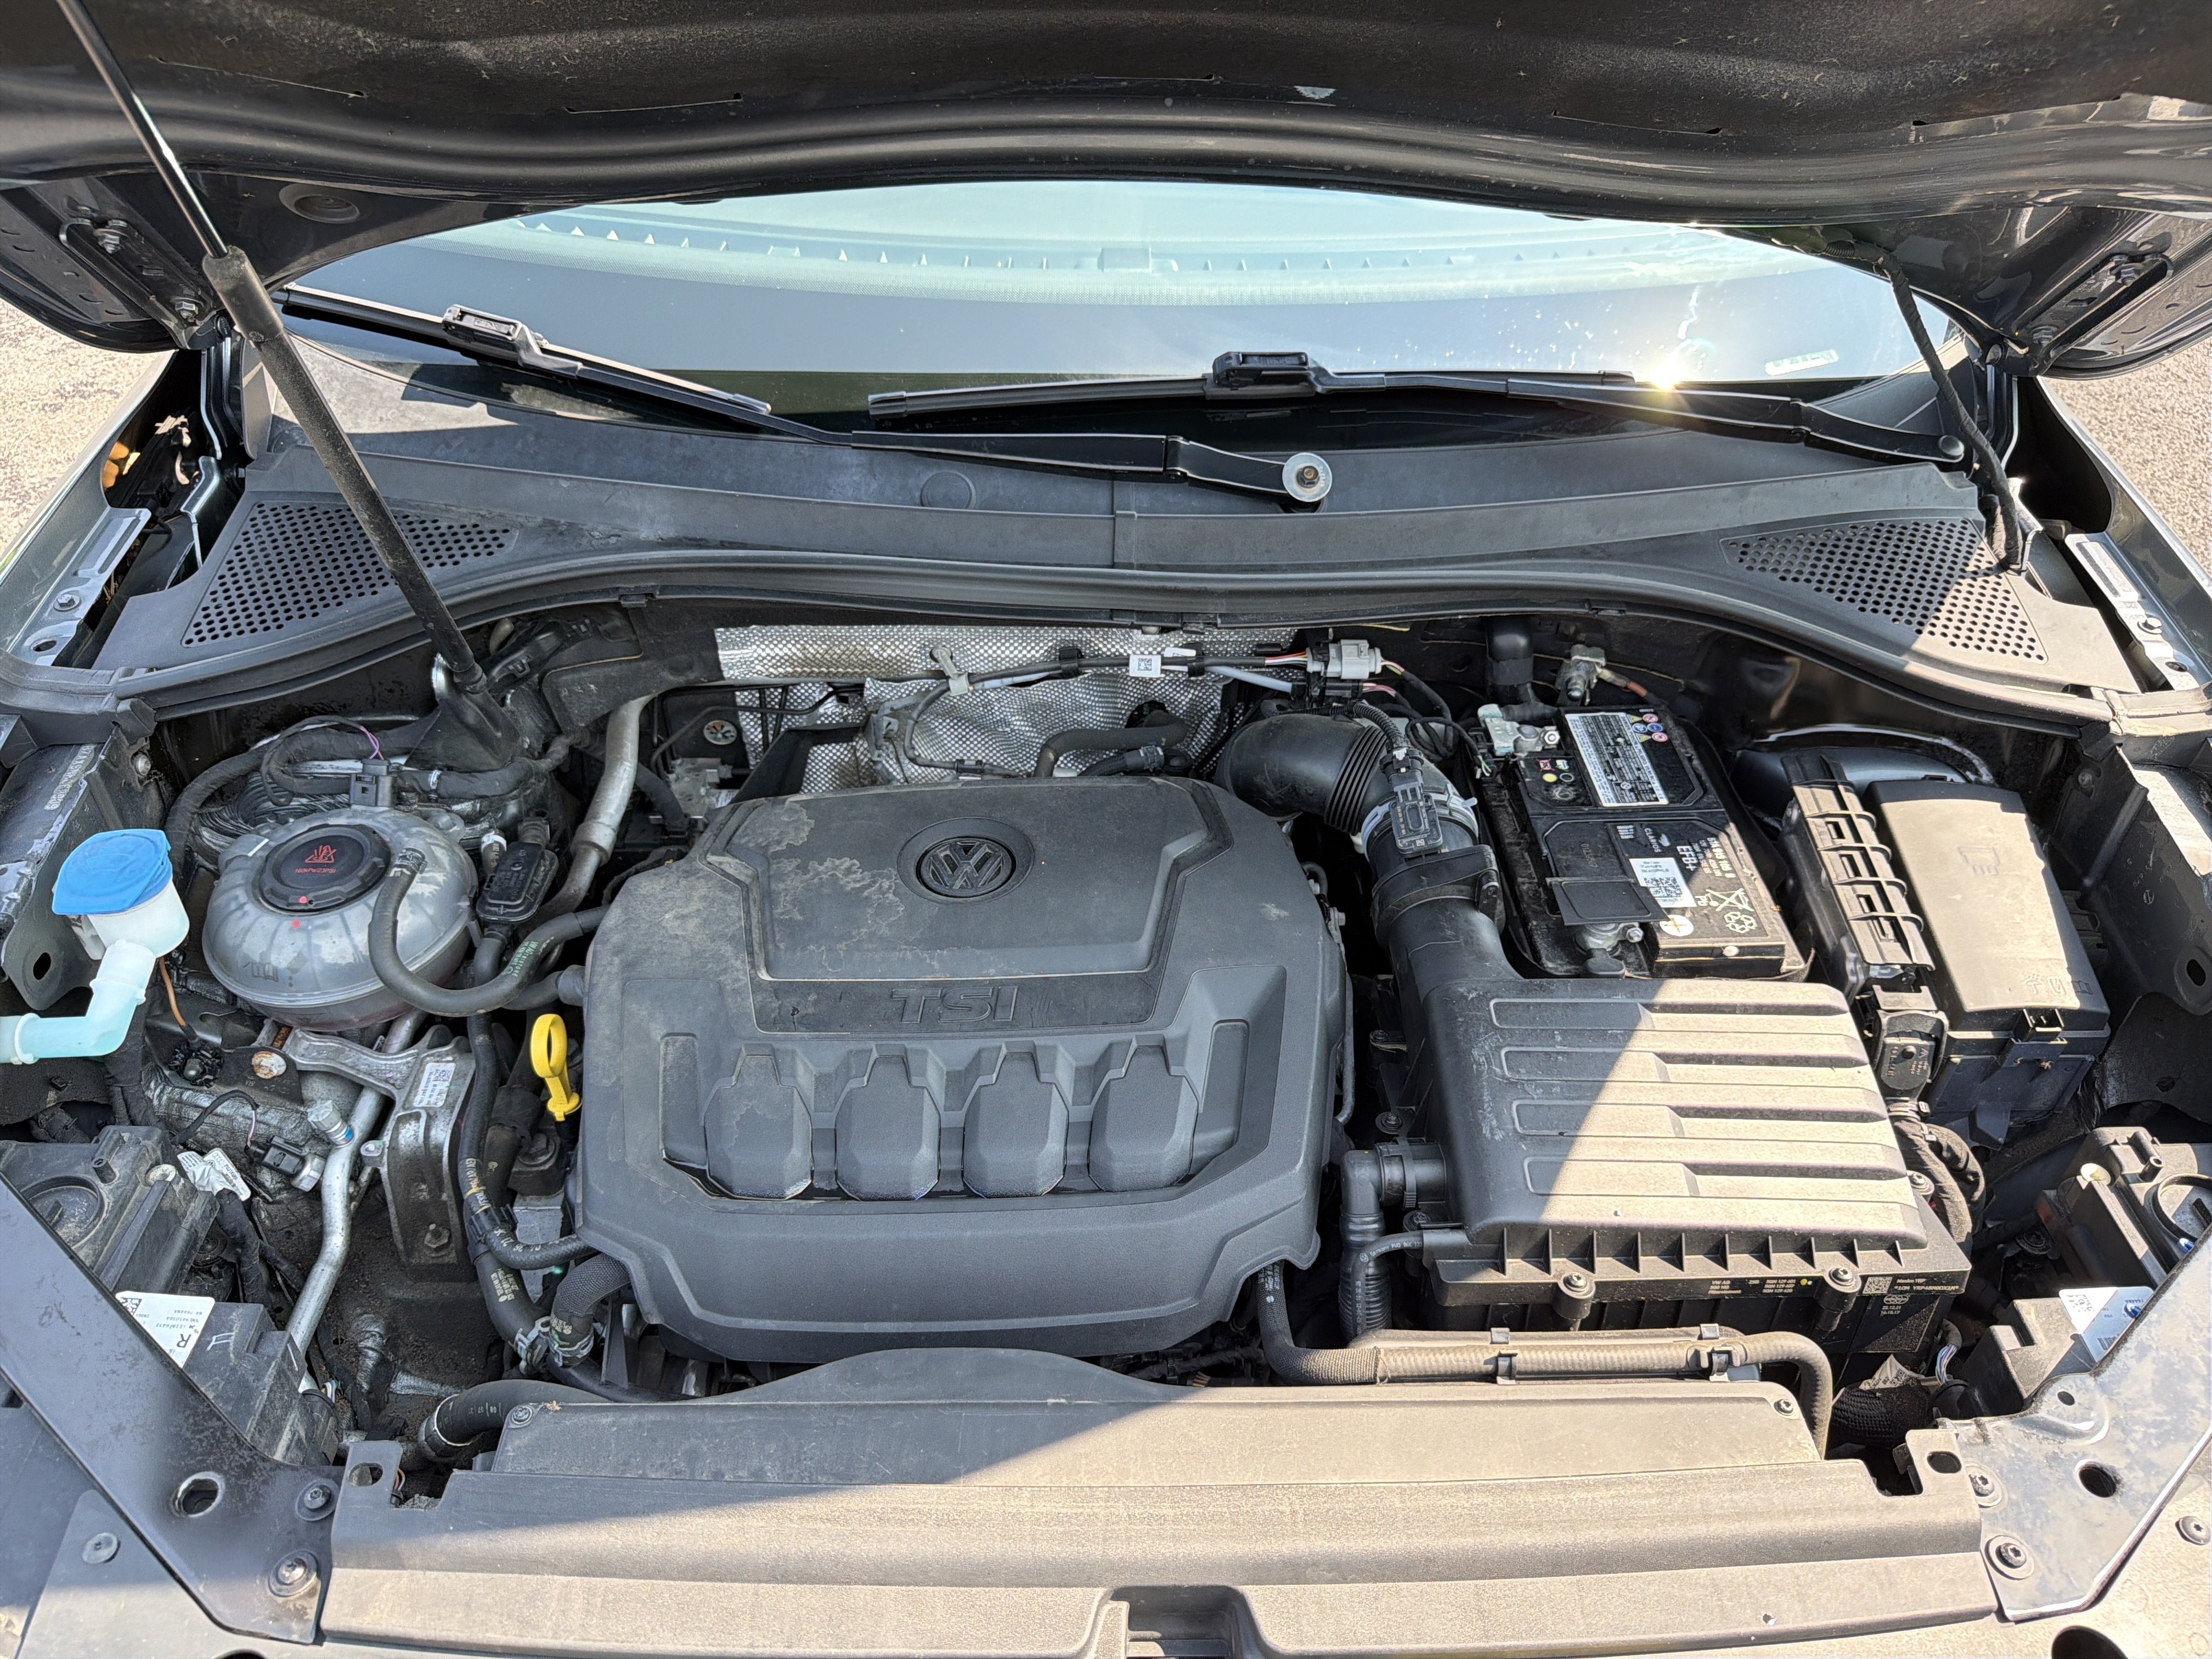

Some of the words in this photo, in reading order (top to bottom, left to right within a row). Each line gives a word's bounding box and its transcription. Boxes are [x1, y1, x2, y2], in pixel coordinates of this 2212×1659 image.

[922, 838, 1011, 894] VW
[1676, 845, 1699, 871] EFB+
[890, 986, 1018, 1024] TSI
[176, 1333, 192, 1348] R
